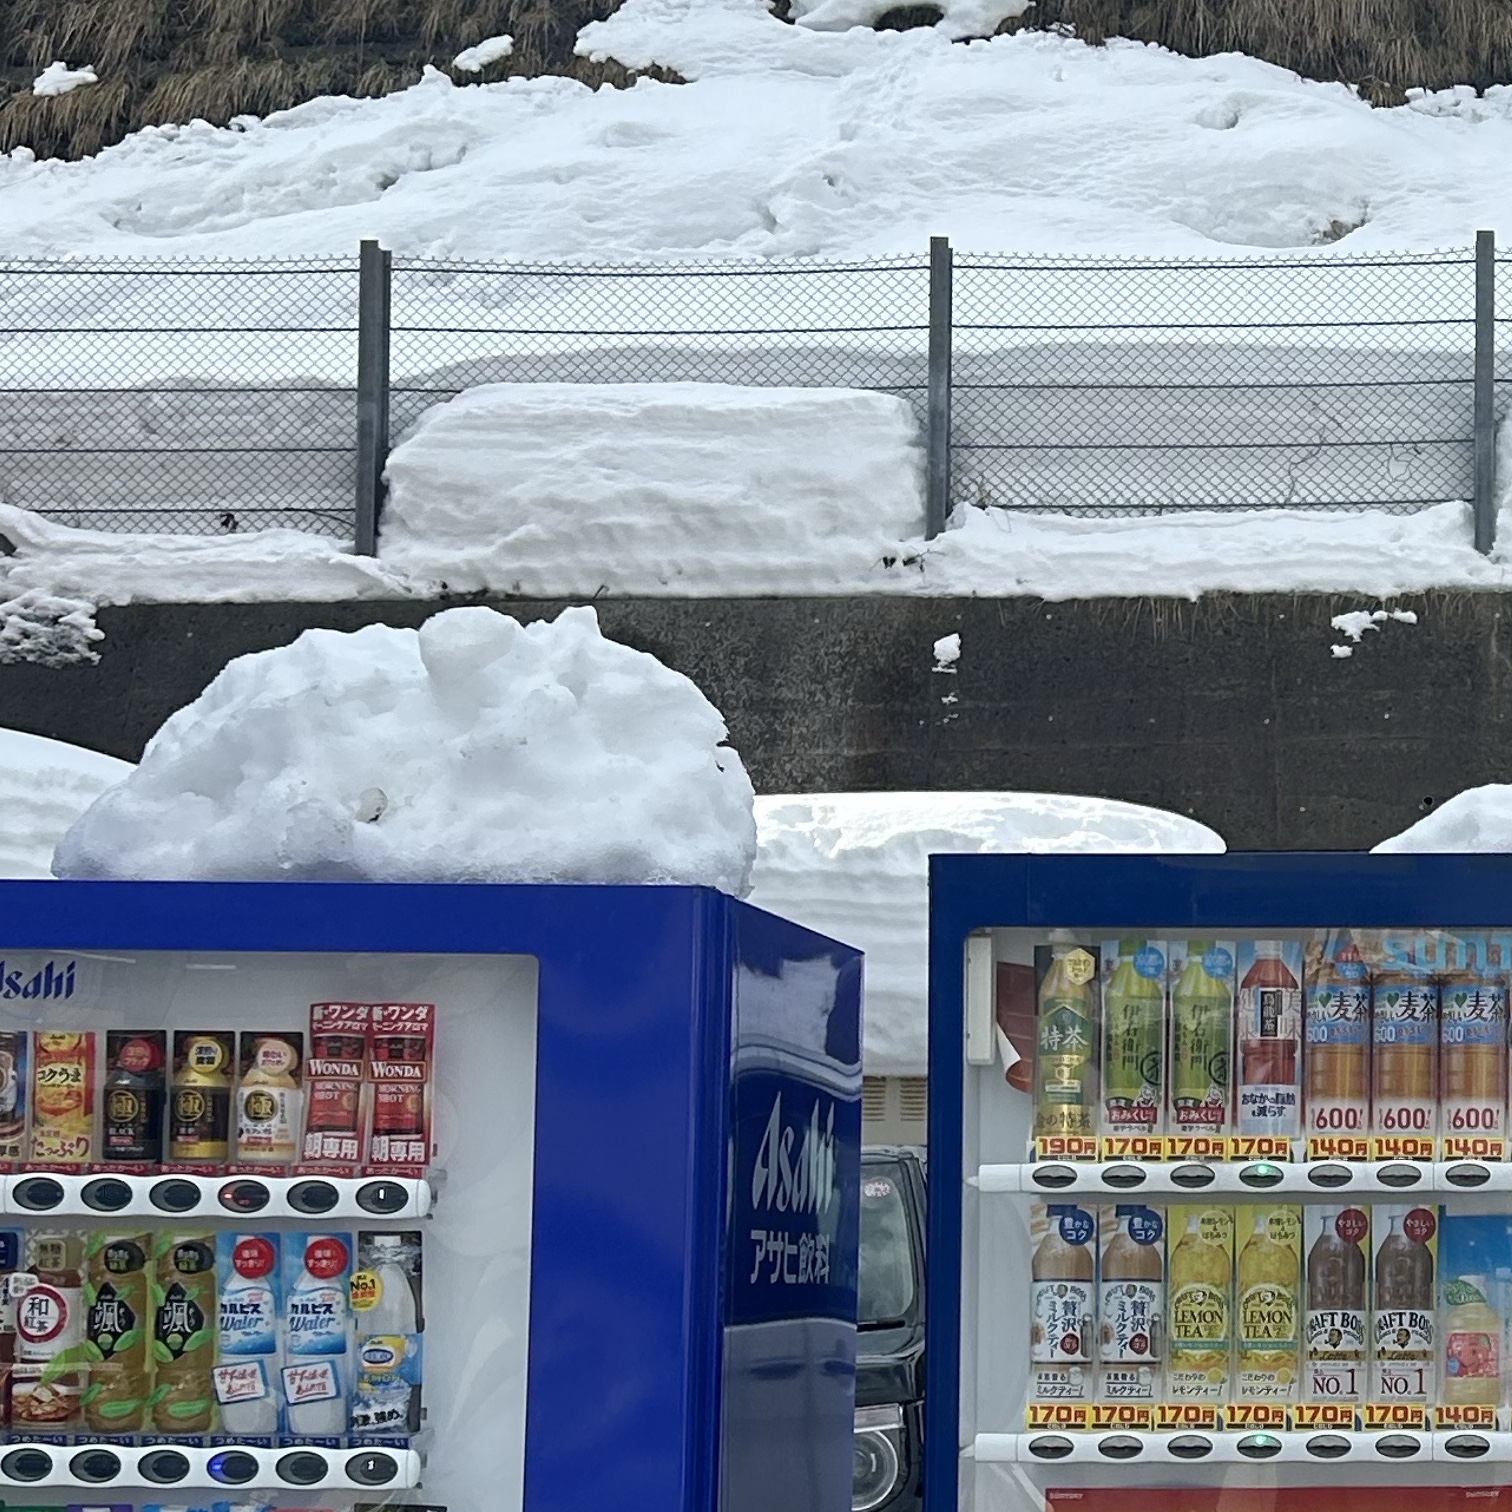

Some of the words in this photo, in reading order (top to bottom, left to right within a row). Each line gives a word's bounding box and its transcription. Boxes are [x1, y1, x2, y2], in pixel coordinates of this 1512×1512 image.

[0, 960, 77, 1000] sahi
[1332, 990, 1368, 1022] 麦茶
[1399, 990, 1437, 1022] 麦茶
[1468, 990, 1504, 1022] 麦茶
[1040, 1024, 1090, 1051] 特茶
[1122, 1003, 1142, 1072] 伊右衛門
[1190, 1003, 1210, 1072] 伊右衛門
[36, 1067, 82, 1084] コクうま
[308, 1059, 360, 1077] WONDA
[372, 1061, 421, 1079] WONDA
[1316, 1107, 1357, 1130] 600
[1383, 1107, 1426, 1130] 600
[1452, 1107, 1494, 1130] 600
[303, 1132, 359, 1161] 朝専用
[371, 1135, 425, 1163] 朝専用
[752, 1089, 835, 1215] Asahi
[1038, 1138, 1097, 1155] 190円
[1104, 1138, 1162, 1155] 170円
[1167, 1138, 1225, 1155] 170円
[1231, 1138, 1288, 1155] 170円
[1309, 1138, 1368, 1155] 140円
[1374, 1138, 1433, 1155] 140円
[1443, 1138, 1503, 1155] 140円
[1063, 1216, 1090, 1230] 豊かな
[1131, 1216, 1158, 1230] 豊かな
[1346, 1227, 1360, 1236] コク
[1414, 1227, 1428, 1236] コク
[1066, 1230, 1087, 1241] コク
[1134, 1230, 1155, 1241] コク
[749, 1229, 830, 1285] アサヒ飲料
[28, 1297, 50, 1317] 和
[219, 1302, 263, 1315] カルピス
[289, 1302, 335, 1315] カルピス
[220, 1316, 264, 1332] Water
[289, 1316, 336, 1332] Water
[1061, 1301, 1078, 1333] 贅沢
[1130, 1301, 1147, 1333] 贅沢
[1174, 1310, 1224, 1324] LEMON
[1242, 1310, 1292, 1324] LEMON
[1046, 1300, 1059, 1359] ミルクティー
[1115, 1300, 1128, 1359] ミルクティー
[1175, 1324, 1203, 1339] TEA
[1243, 1324, 1271, 1339] TEA
[1312, 1368, 1360, 1396] NO.1
[1380, 1368, 1428, 1396] NO.1
[1028, 1405, 1087, 1422] 170円
[1091, 1405, 1150, 1422] 170円
[1156, 1405, 1215, 1422] 170円
[1226, 1405, 1285, 1422] 170円
[1295, 1405, 1353, 1422] 170円
[1365, 1405, 1423, 1422] 170円
[1435, 1405, 1494, 1422] 140円
